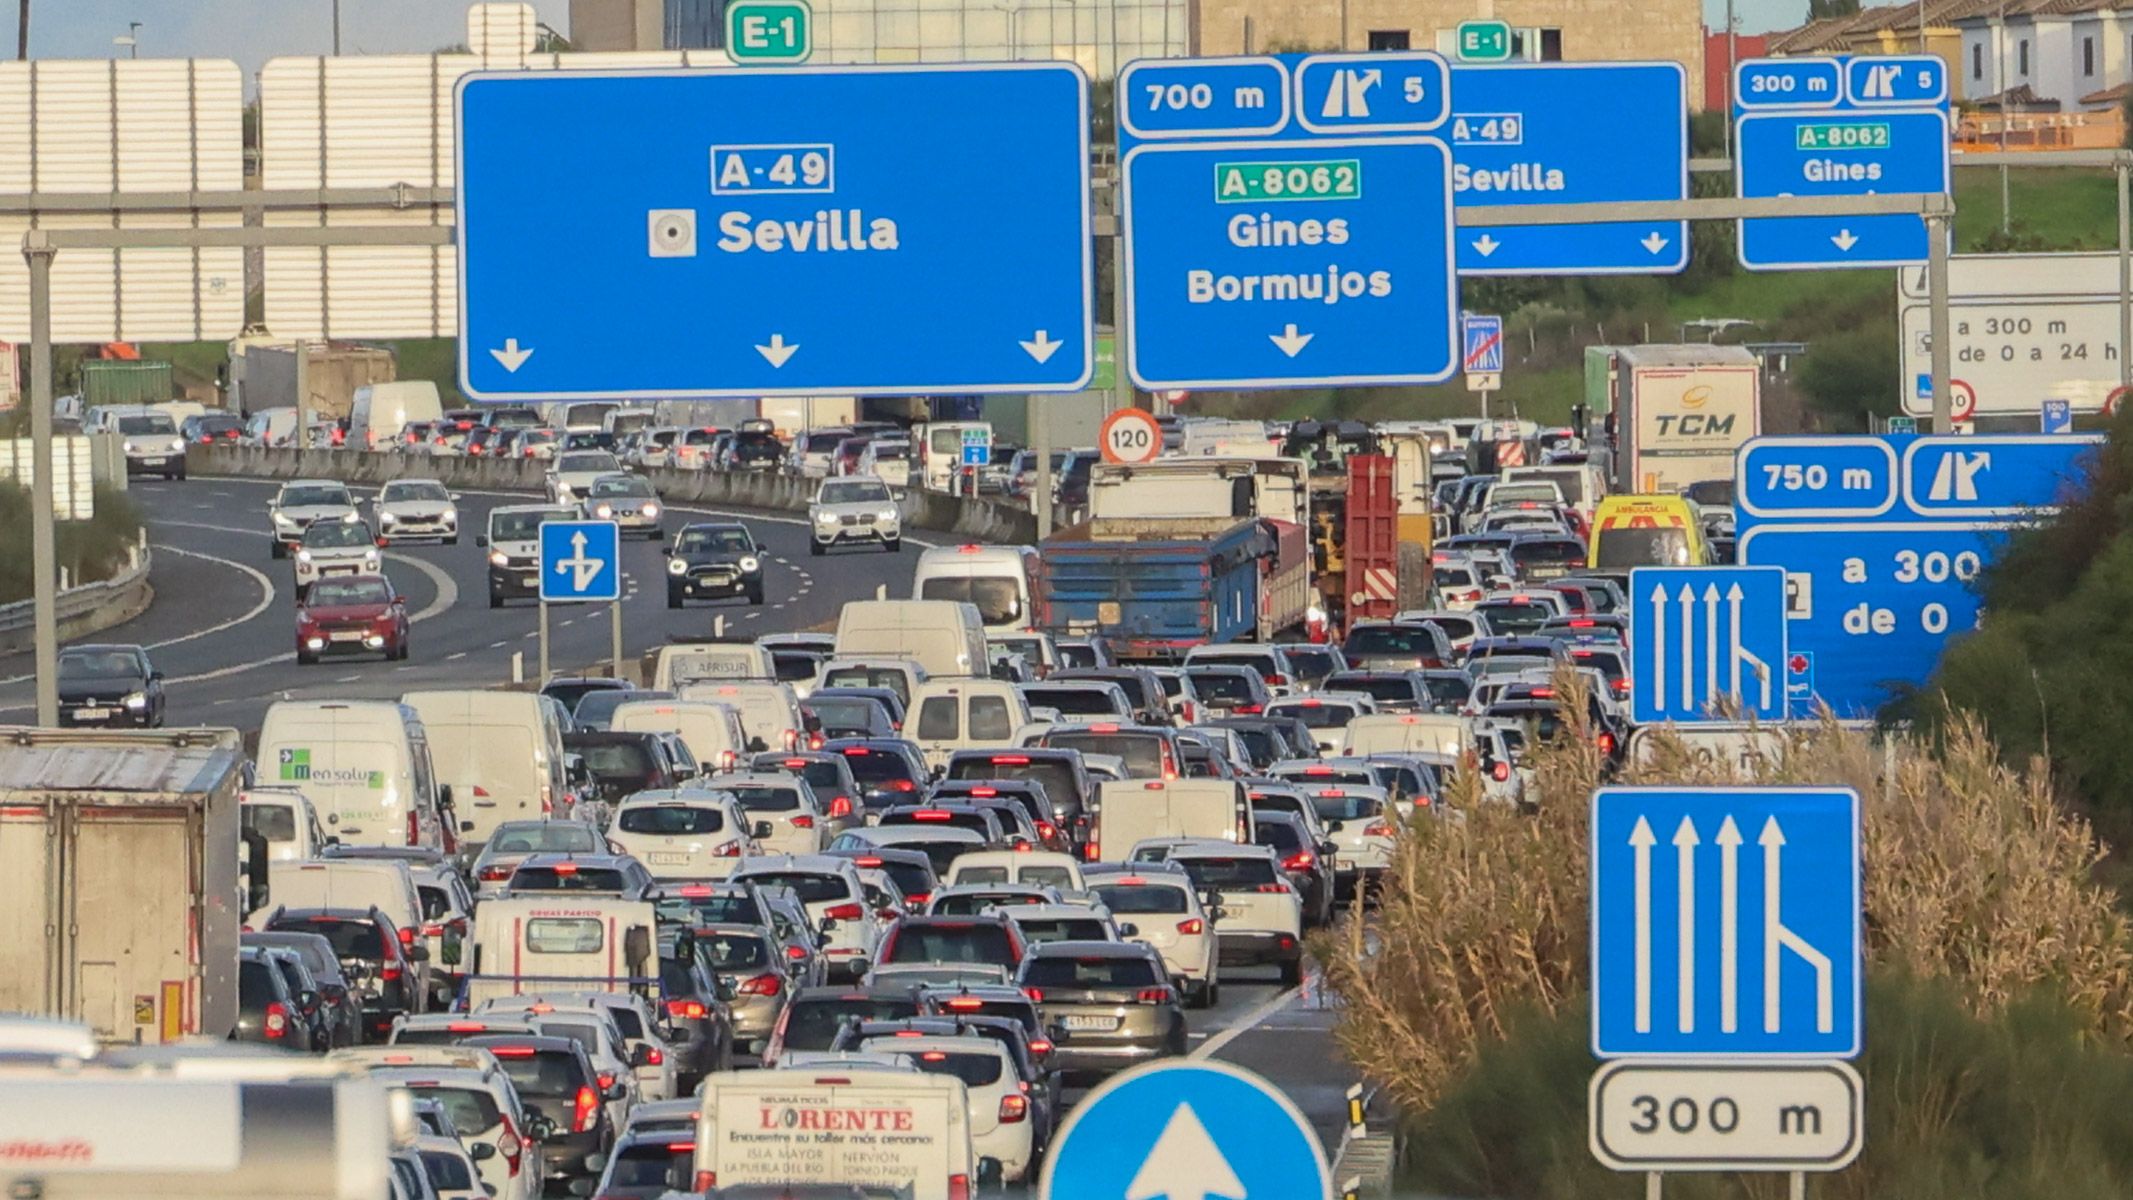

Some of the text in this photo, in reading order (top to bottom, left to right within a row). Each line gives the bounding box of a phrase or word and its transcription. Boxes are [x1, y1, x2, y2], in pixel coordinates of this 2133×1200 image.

[743, 16, 794, 47] E-1
[1466, 32, 1502, 50] E-1
[1404, 77, 1424, 103] 5
[1751, 75, 1827, 92] 300 m
[1918, 71, 1932, 89] 5
[1146, 84, 1264, 111] 700 m
[1453, 118, 1517, 140] A-49
[1801, 127, 1886, 146] A-8062
[720, 152, 827, 187] A-49
[1222, 167, 1354, 196] A-8062
[1454, 162, 1565, 192] Sevilla
[1803, 158, 1882, 182] Gines
[717, 209, 899, 253] Sevilla
[1228, 212, 1349, 247] Gines
[1188, 264, 1391, 304] Bormujos
[1958, 318, 2067, 335] a 300 m
[1958, 342, 2117, 362] de 0 a 24 h
[1655, 414, 1736, 436] TCM
[1112, 429, 1148, 448] 120
[1763, 464, 1872, 490] 750 m
[1615, 505, 1669, 513] AMBULANCIA
[1842, 549, 1981, 583] a 300
[1843, 602, 1896, 635] de
[1921, 602, 1948, 634] 0
[760, 1108, 913, 1131] LORENTE
[1629, 1095, 1822, 1134] 300 m
[730, 1131, 790, 1143] Encuentre
[796, 1134, 809, 1143] su
[815, 1132, 845, 1144] taller
[747, 1149, 823, 1159] ISLA MAYOR
